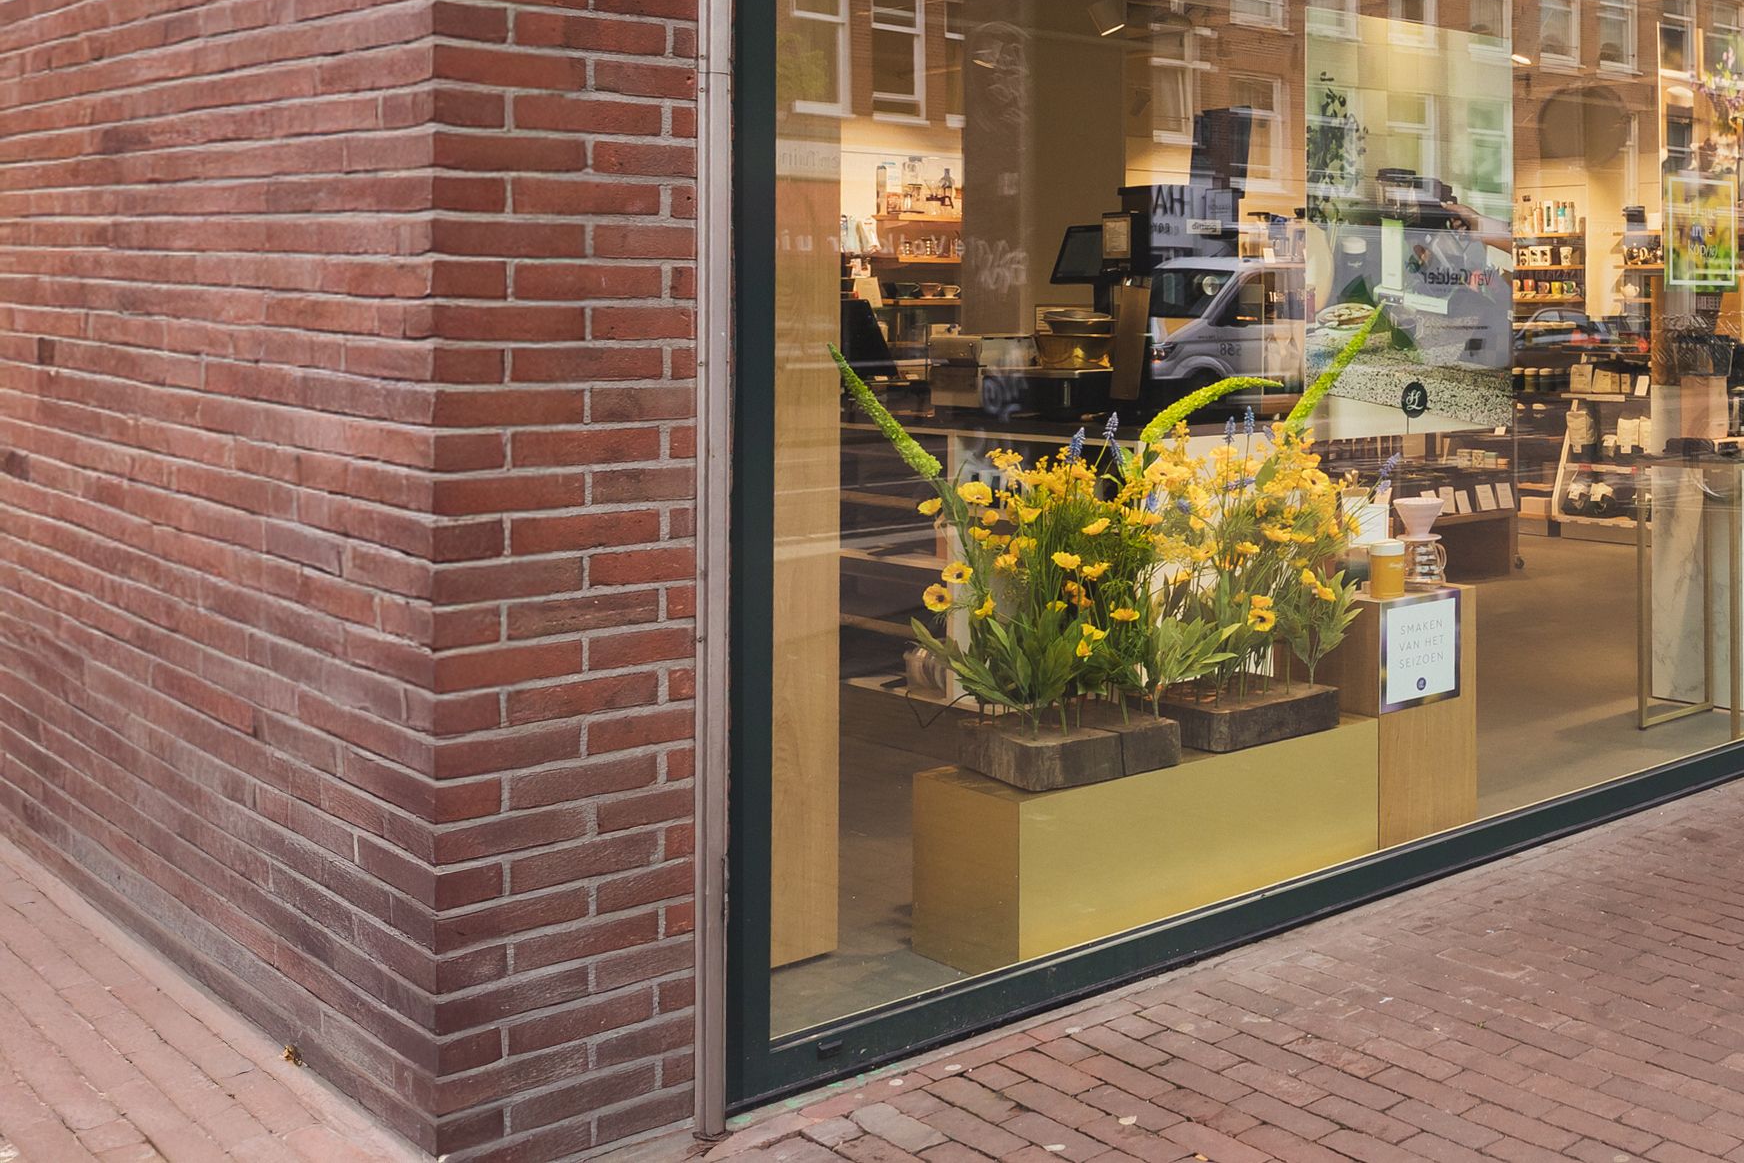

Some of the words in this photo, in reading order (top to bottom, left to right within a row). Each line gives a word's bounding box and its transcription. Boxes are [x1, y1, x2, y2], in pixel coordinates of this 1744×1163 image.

[1400, 619, 1443, 635] SMAKEN
[1399, 640, 1420, 652] VAN
[1425, 635, 1444, 646] HET
[1399, 651, 1444, 669] SEIZOEN
